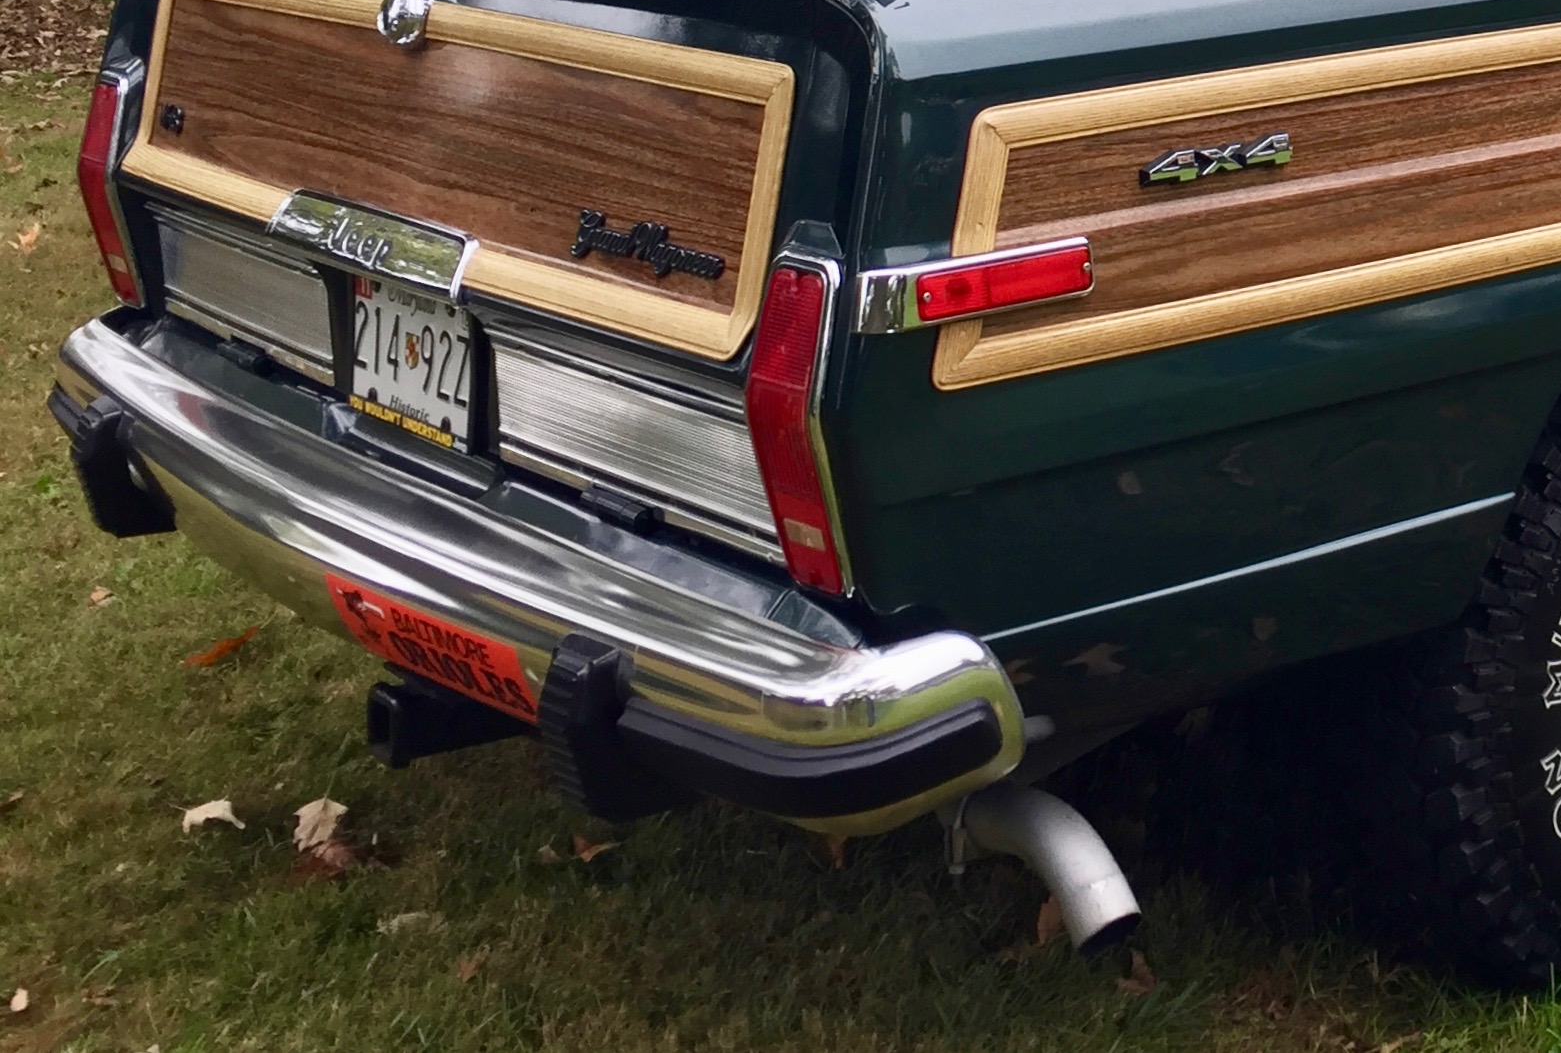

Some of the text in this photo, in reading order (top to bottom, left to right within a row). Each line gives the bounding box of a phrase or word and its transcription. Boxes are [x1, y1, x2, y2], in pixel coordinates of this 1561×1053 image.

[326, 207, 391, 269] Jeep
[354, 300, 471, 407] 214 927
[389, 395, 430, 424] Historic
[390, 606, 495, 669] BALTIMORE
[387, 630, 537, 716] ORIOLES
